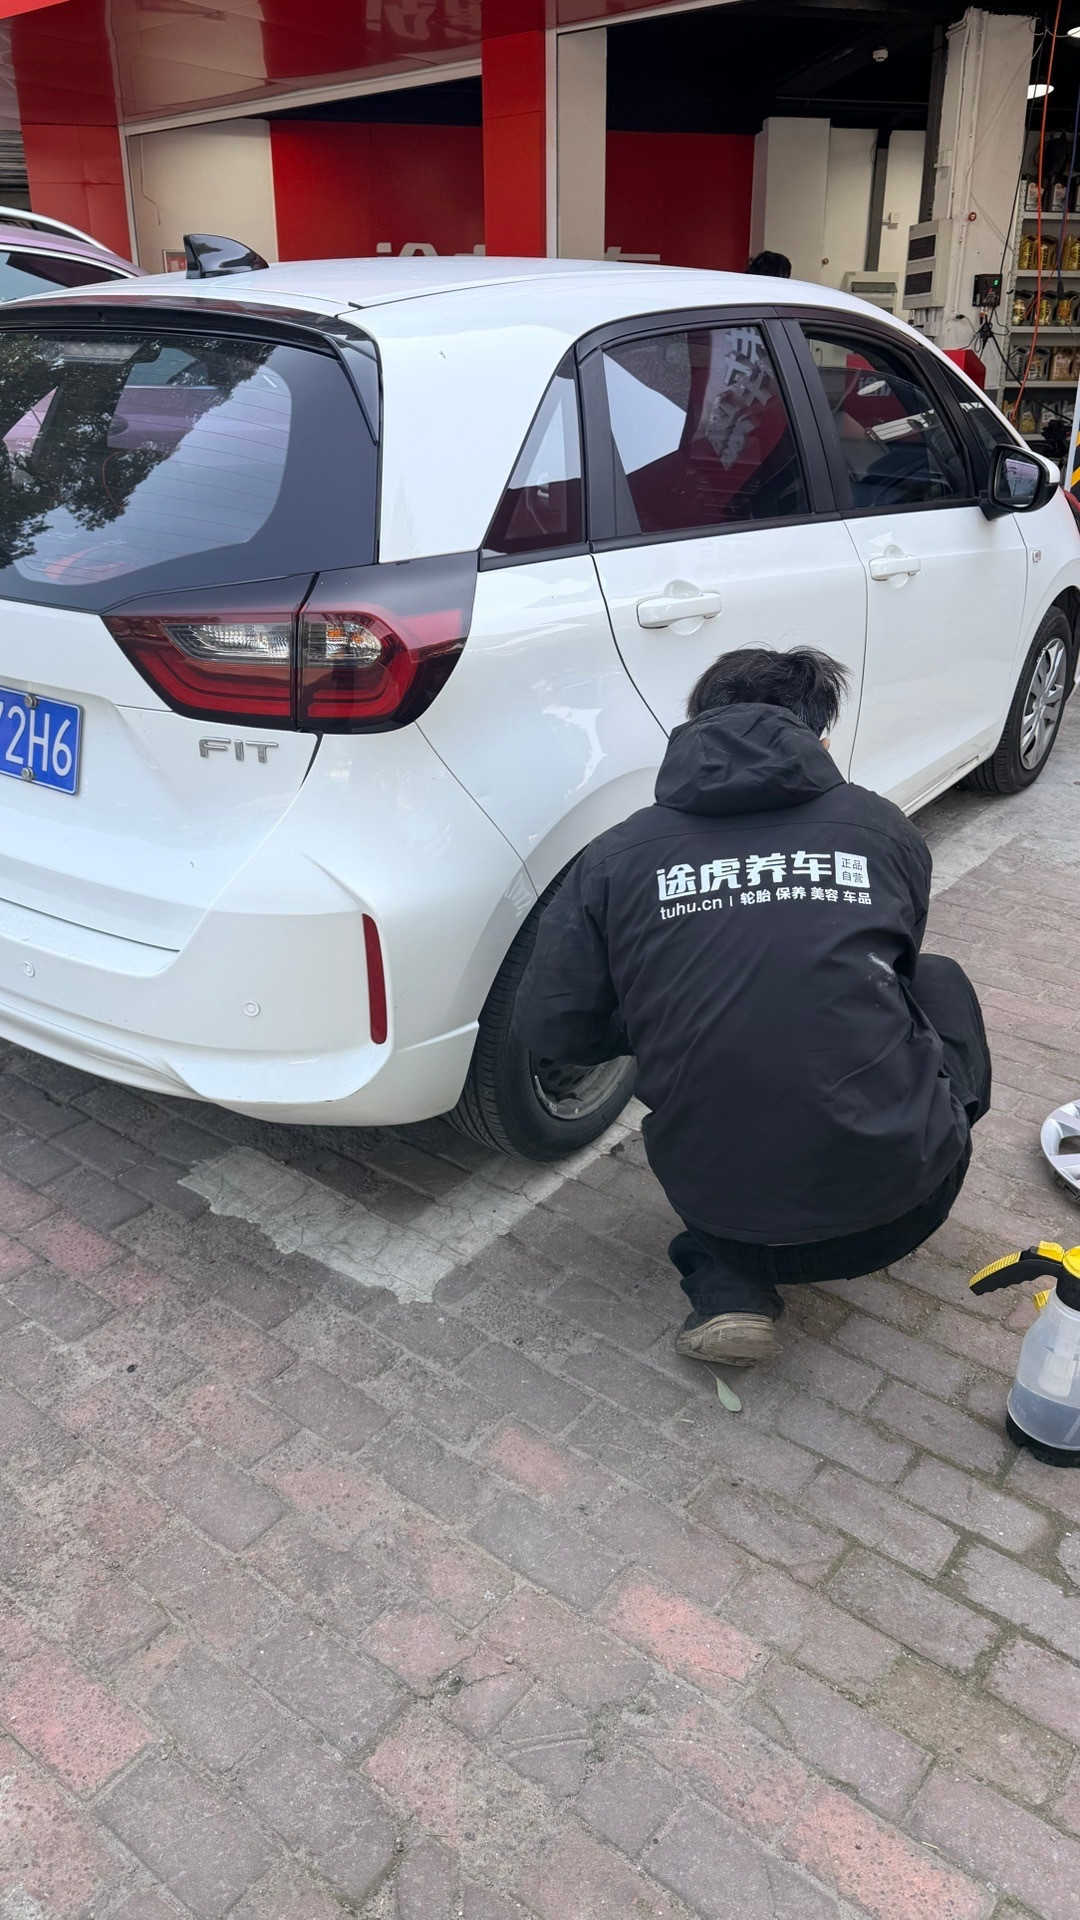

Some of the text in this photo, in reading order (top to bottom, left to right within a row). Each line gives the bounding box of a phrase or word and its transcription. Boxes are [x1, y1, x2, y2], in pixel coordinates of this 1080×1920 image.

[198, 736, 279, 764] FIT
[656, 850, 832, 901] 途虎养车
[841, 857, 863, 871] 正品
[660, 886, 872, 920] tuhu.cn 轮胎 保养 美容 车品
